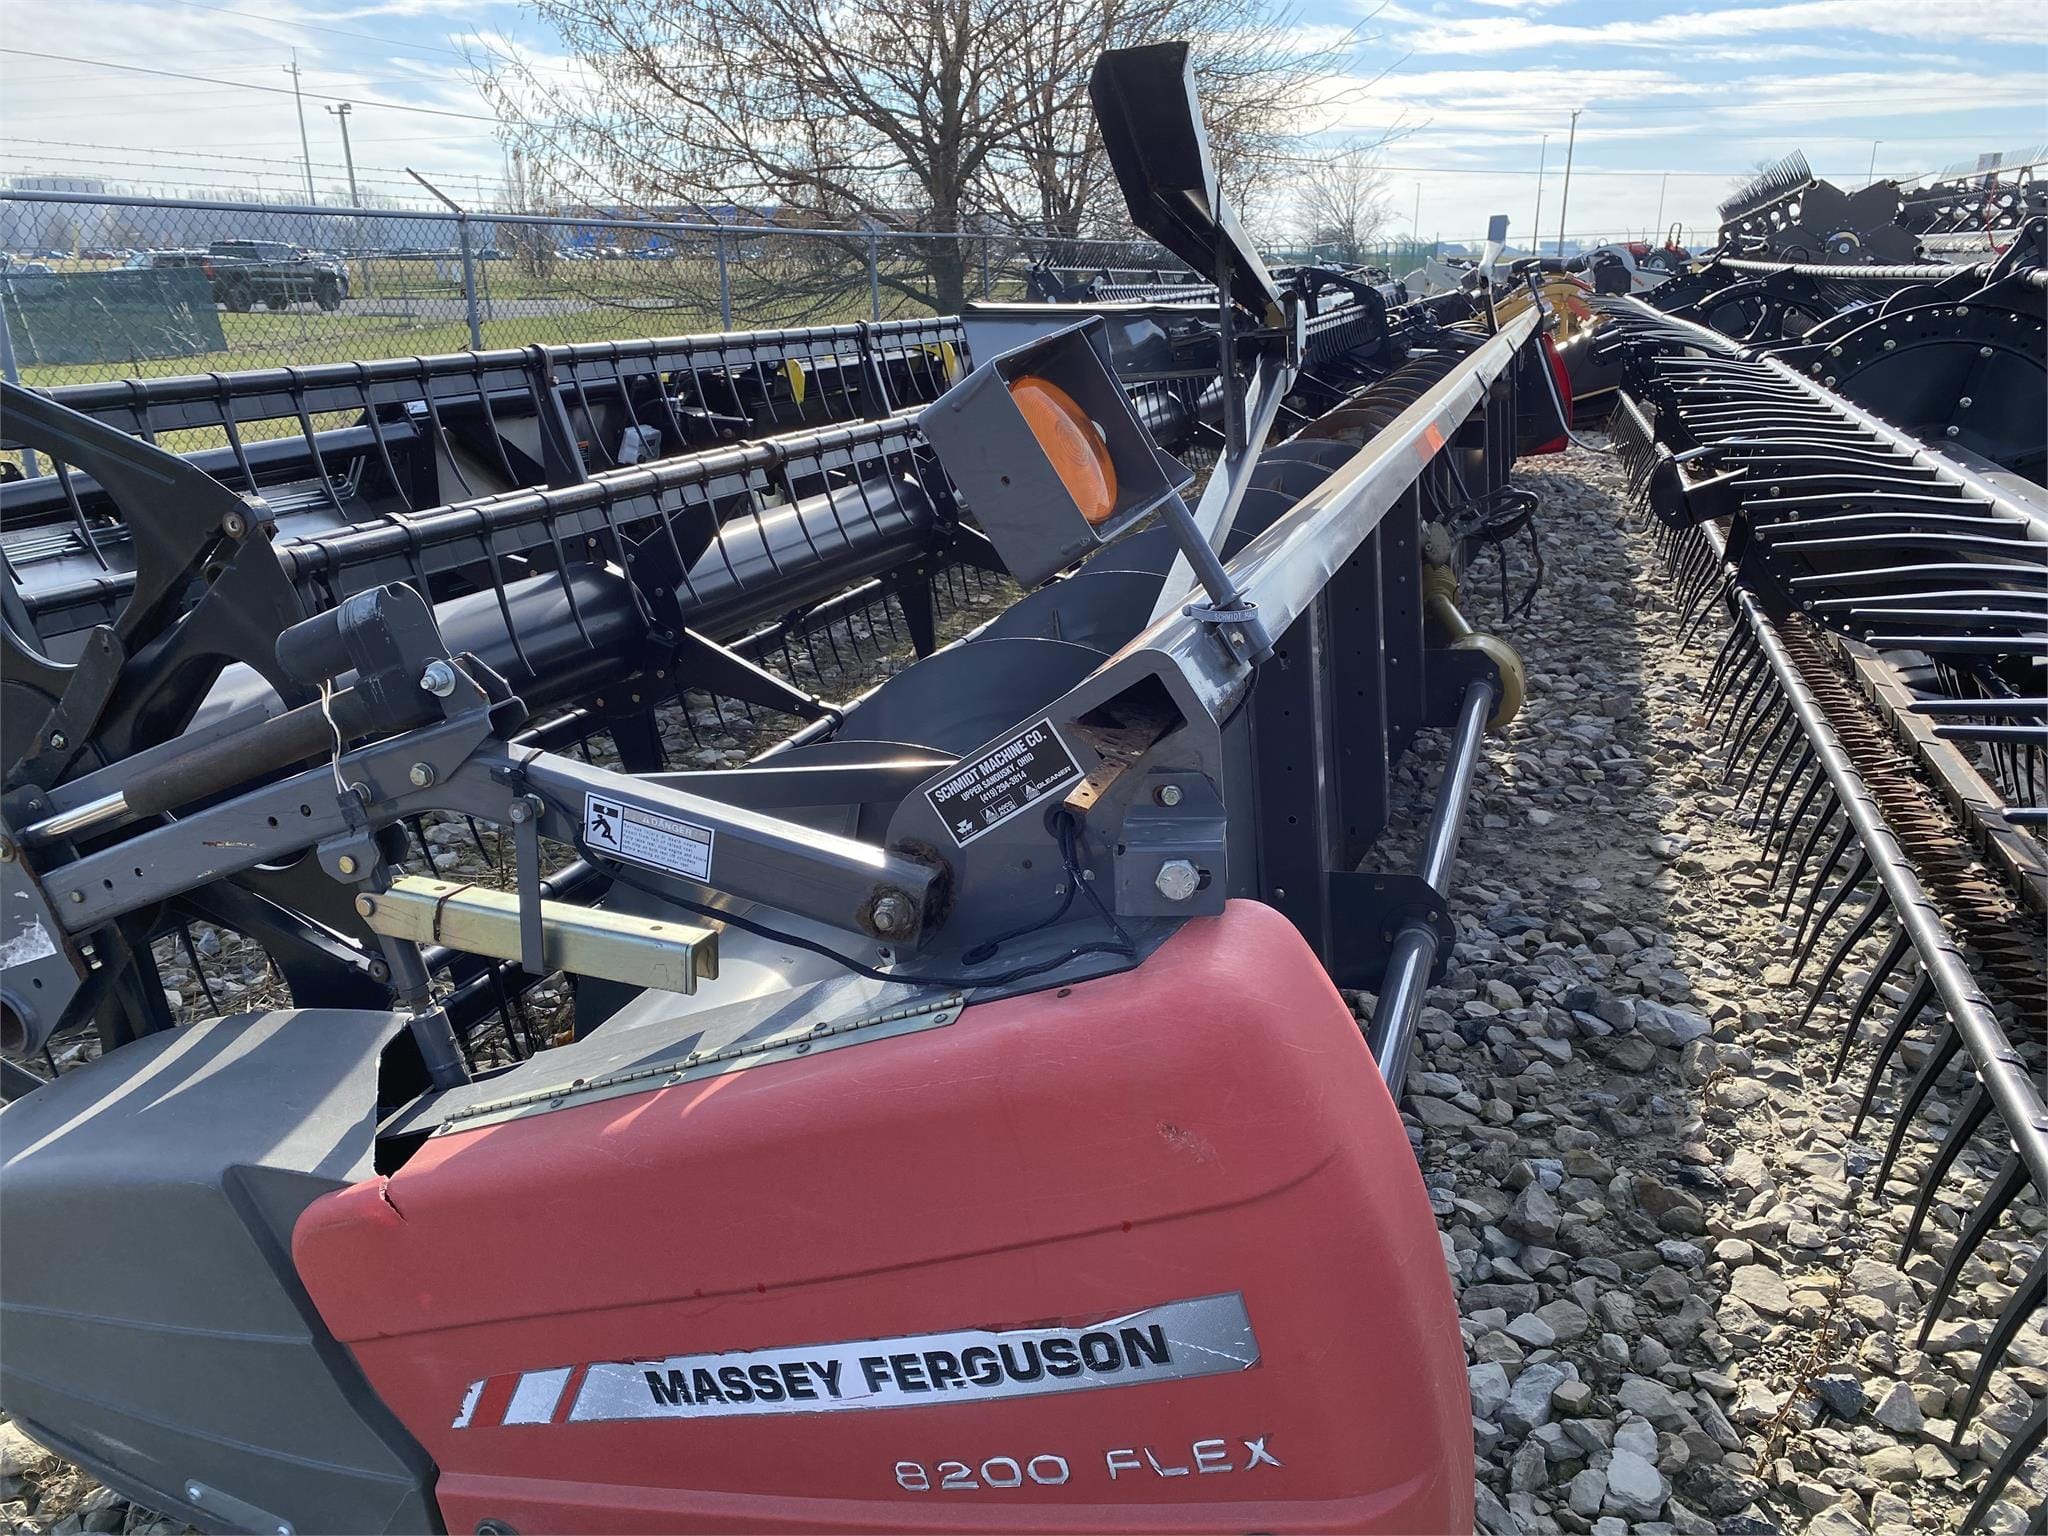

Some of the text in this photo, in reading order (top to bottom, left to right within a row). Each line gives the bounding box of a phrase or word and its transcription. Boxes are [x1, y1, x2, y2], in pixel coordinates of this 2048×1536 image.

[1214, 611, 1241, 621] SCHMIDT
[933, 729, 1047, 803] SCHMIDT MACHINE CO.
[960, 752, 1034, 801] UPPER SANDUSKY, OHIO
[979, 769, 1027, 803] (419) 294-3814
[1035, 765, 1072, 789] GLEANER
[651, 818, 691, 836] DANGER
[645, 1324, 1173, 1406] MASSEY FERGUSON
[895, 1436, 1284, 1491] 8200 FLEX
